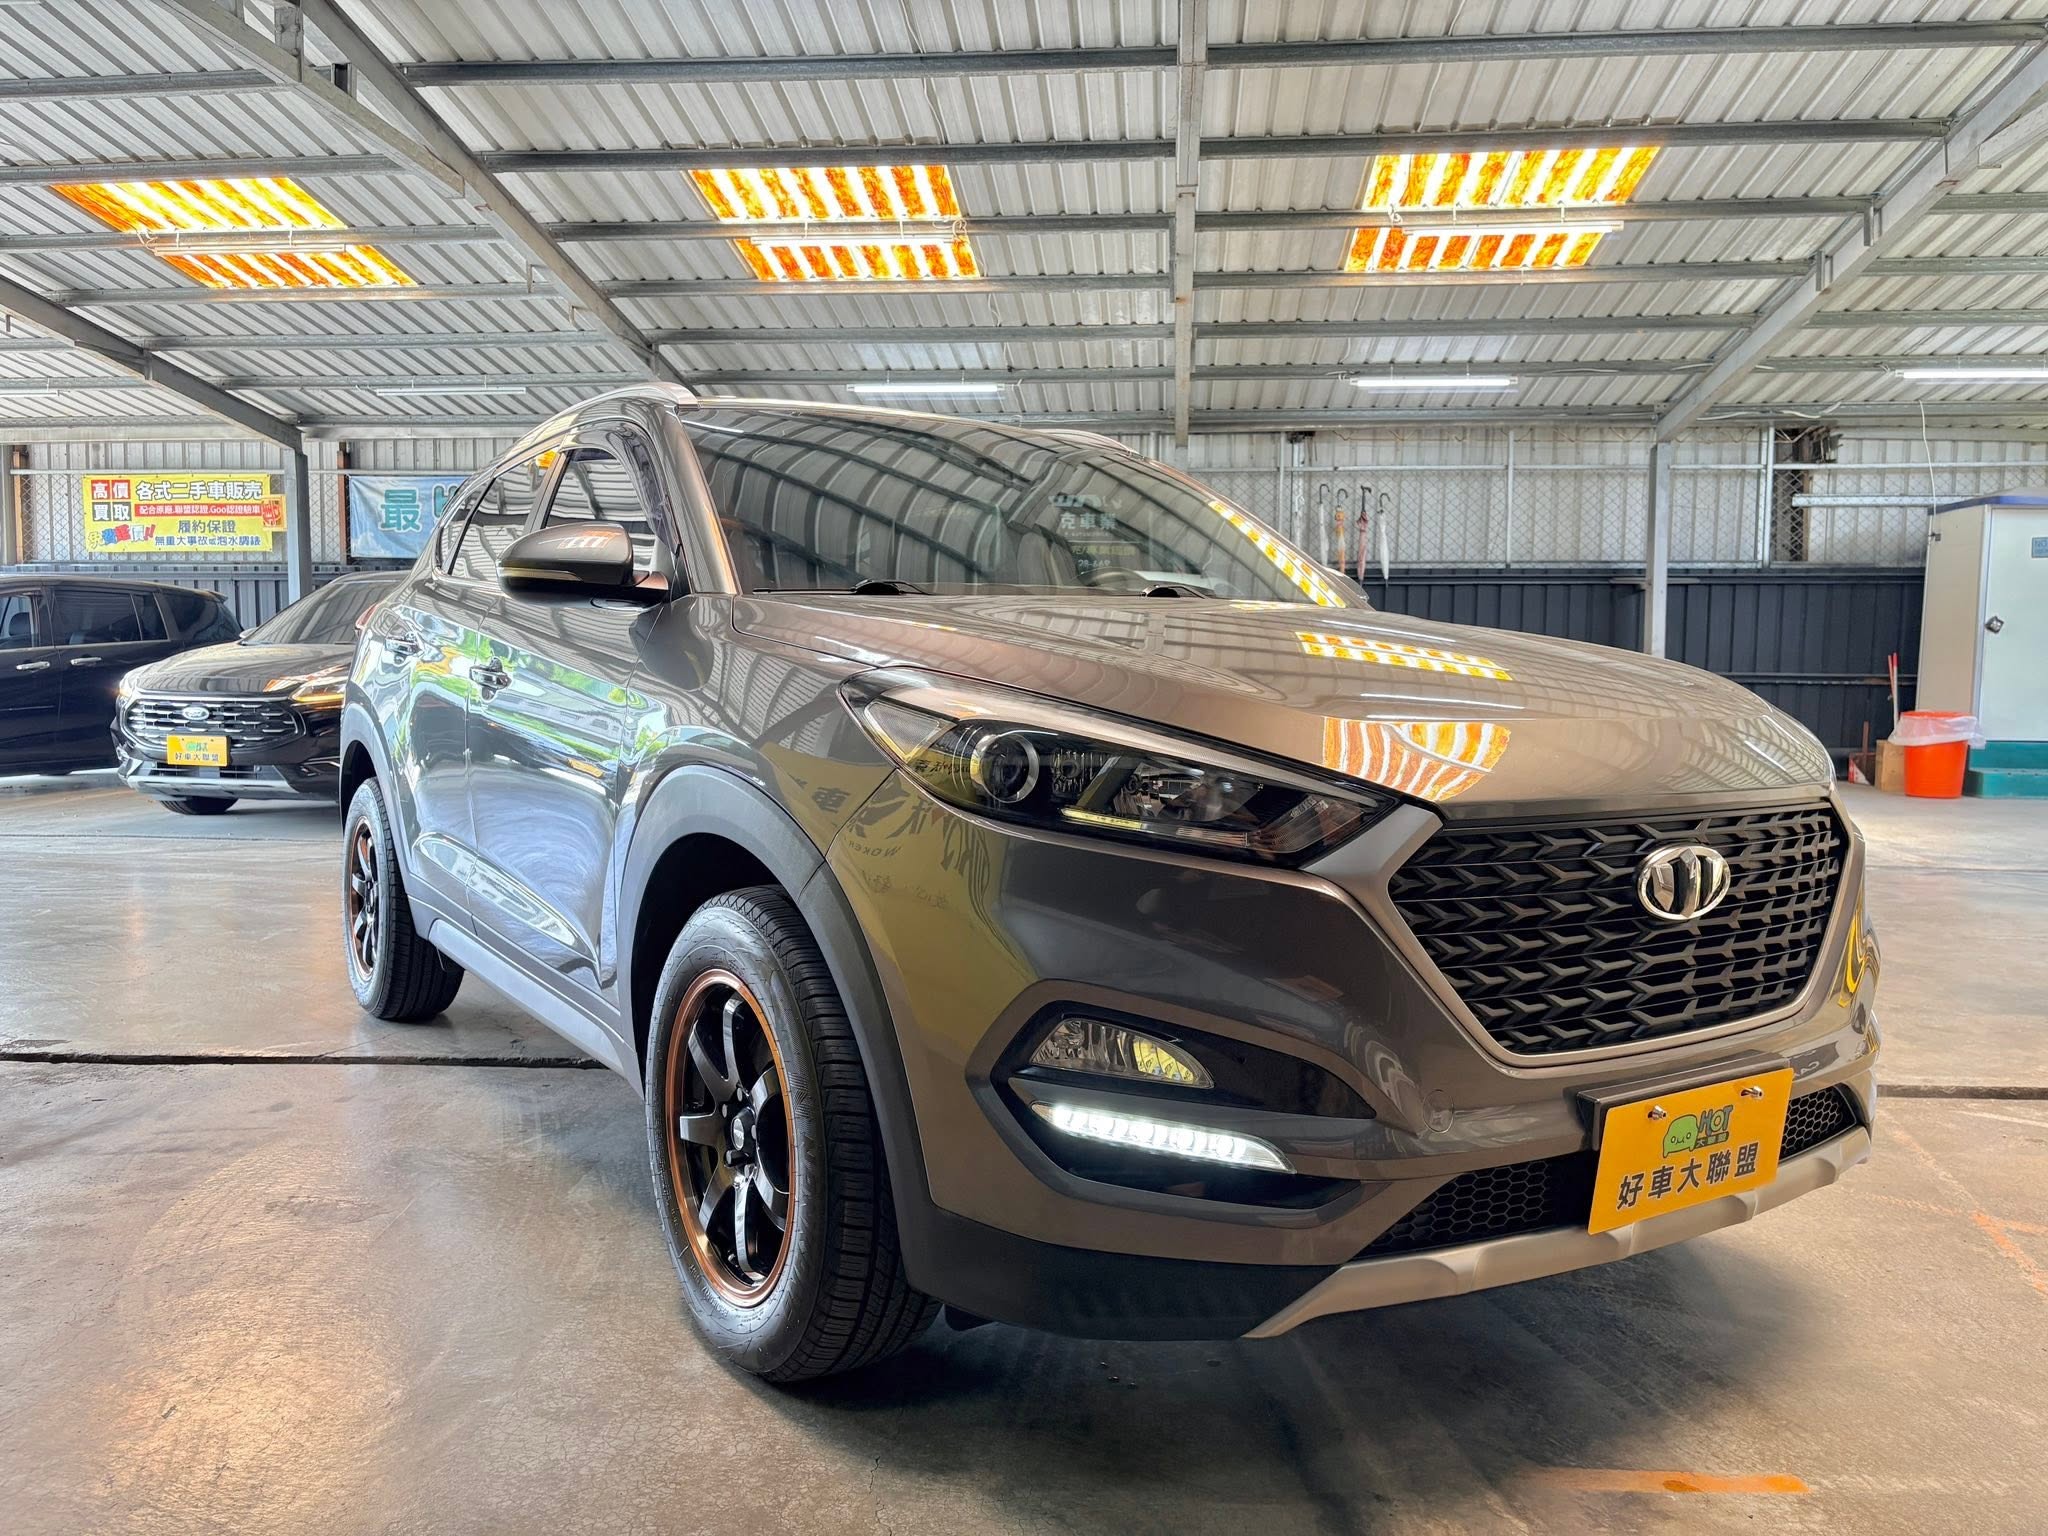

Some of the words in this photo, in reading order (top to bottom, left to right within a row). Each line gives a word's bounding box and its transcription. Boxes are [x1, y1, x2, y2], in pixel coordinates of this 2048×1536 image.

[92, 482, 131, 499] 高價
[93, 503, 132, 520] 買取
[178, 520, 237, 533] 履約保證
[1698, 1104, 1734, 1136] HOT
[1616, 1142, 1759, 1211] 好車大聯盟
